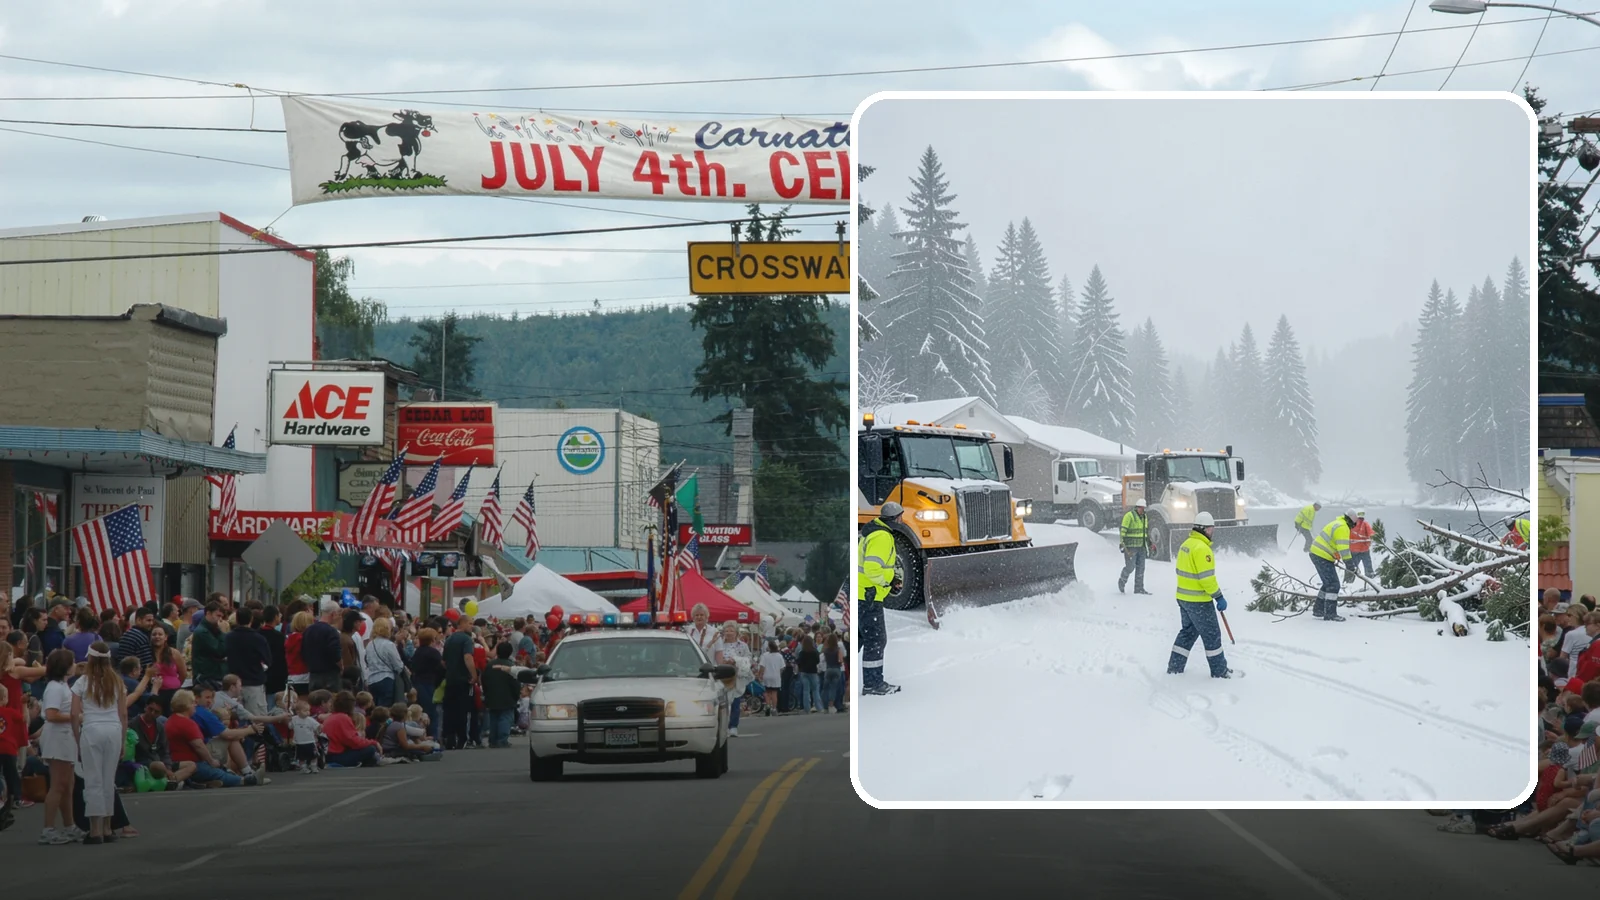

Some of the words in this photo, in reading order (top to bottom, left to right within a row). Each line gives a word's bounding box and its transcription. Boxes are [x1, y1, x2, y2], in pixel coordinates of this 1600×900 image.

[481, 141, 604, 193] JULY
[632, 150, 746, 198] 4th.
[697, 254, 850, 280] CROSSWA
[283, 380, 373, 420] ACE
[405, 409, 452, 422] CEDAR
[283, 421, 371, 436] Hardware
[83, 485, 93, 494] St.
[96, 485, 124, 495] Vincent
[126, 486, 136, 495] de
[137, 486, 155, 495] Paul
[688, 526, 741, 535] CRNATION
[699, 535, 730, 543] GLASS
